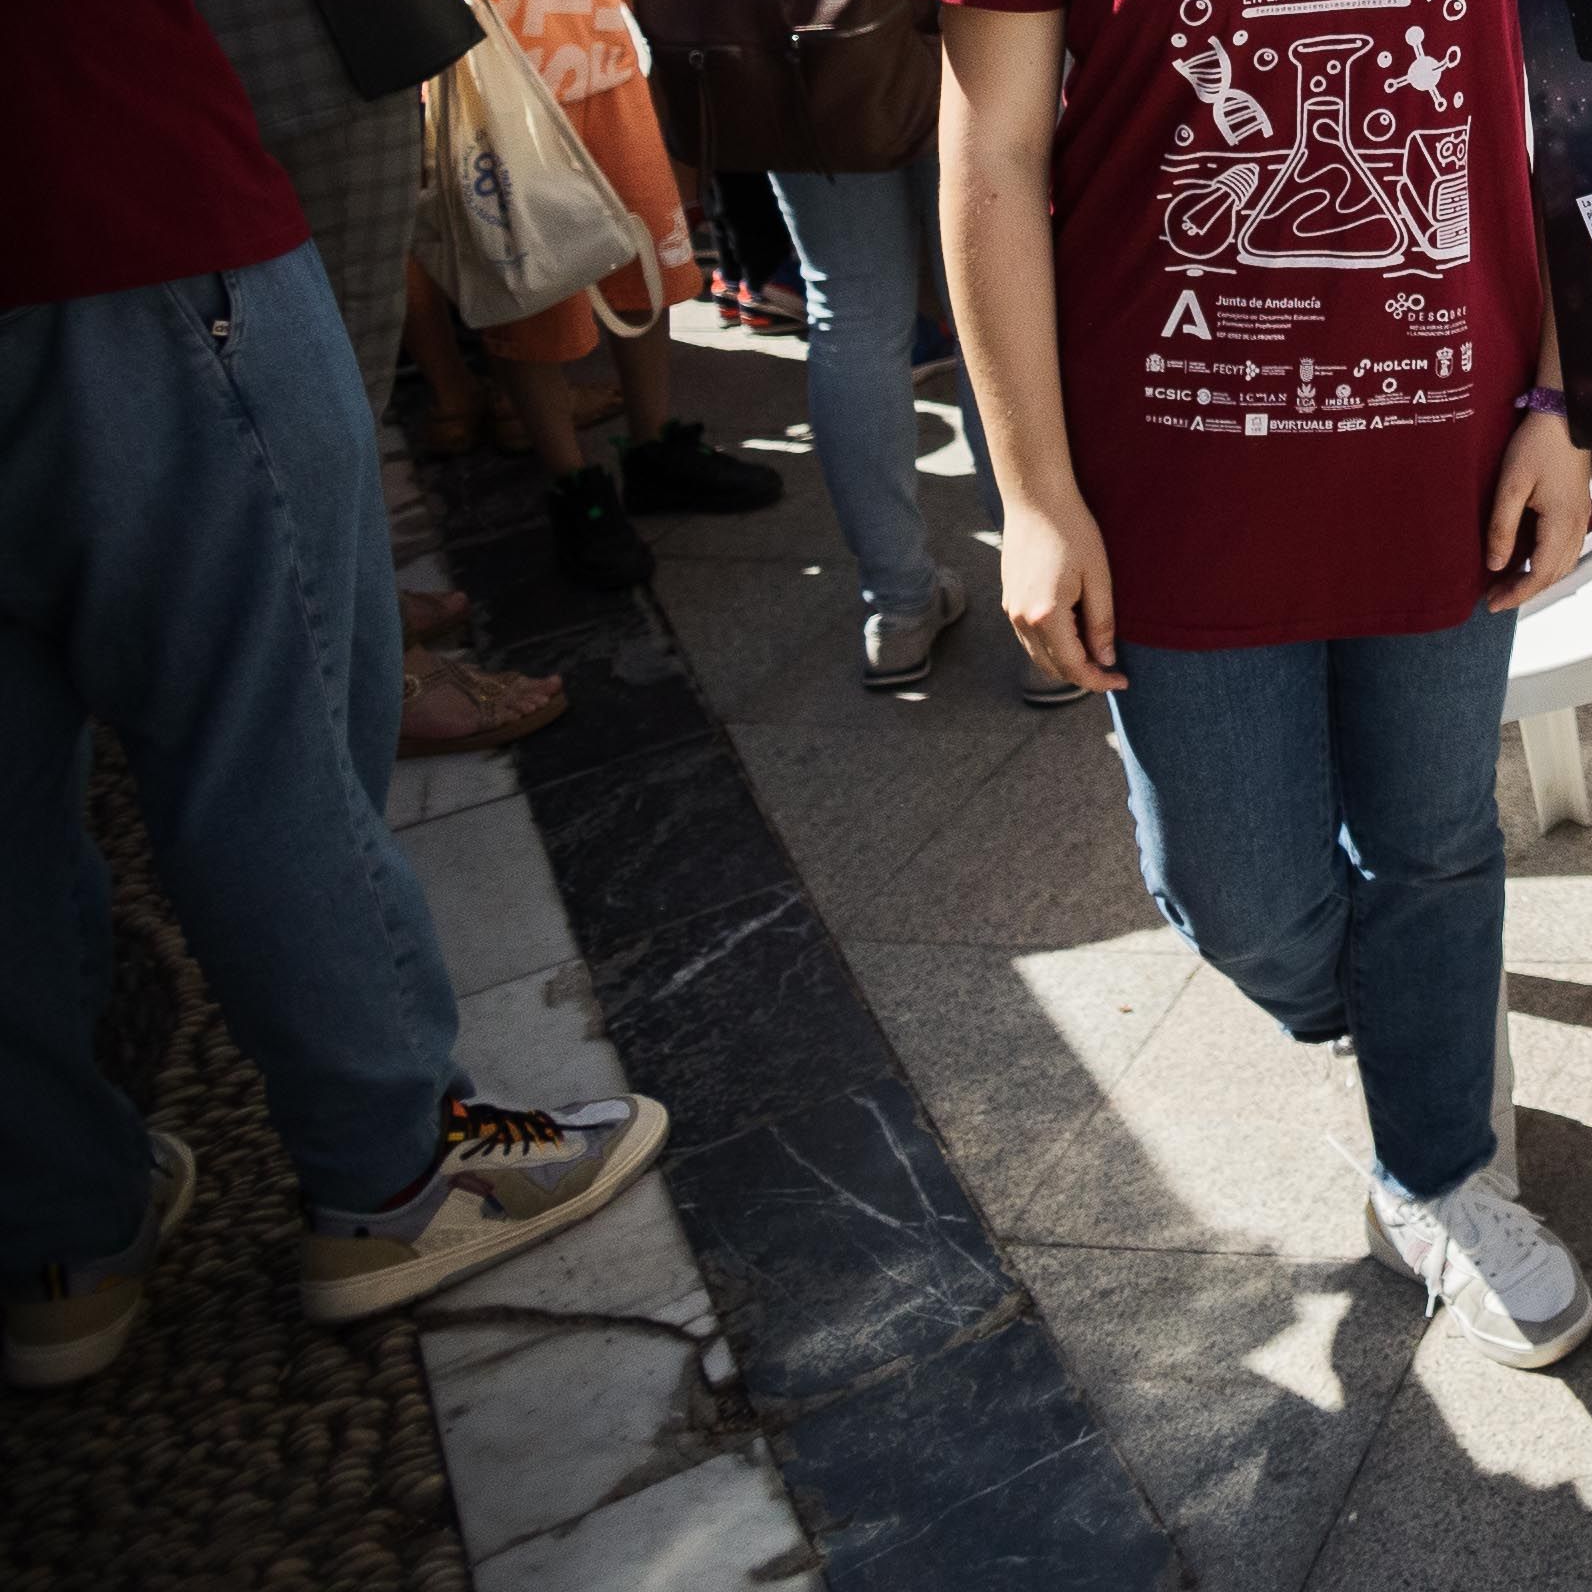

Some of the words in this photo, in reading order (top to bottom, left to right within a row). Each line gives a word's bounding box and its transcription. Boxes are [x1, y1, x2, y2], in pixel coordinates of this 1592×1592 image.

[1582, 199, 1592, 208] La
[1215, 295, 1247, 307] Junta
[1249, 298, 1262, 308] de
[1265, 296, 1321, 309] Andalucía
[1213, 363, 1244, 375] FECYT
[1373, 359, 1428, 373] HOLCIM
[1154, 387, 1192, 401] CSIC
